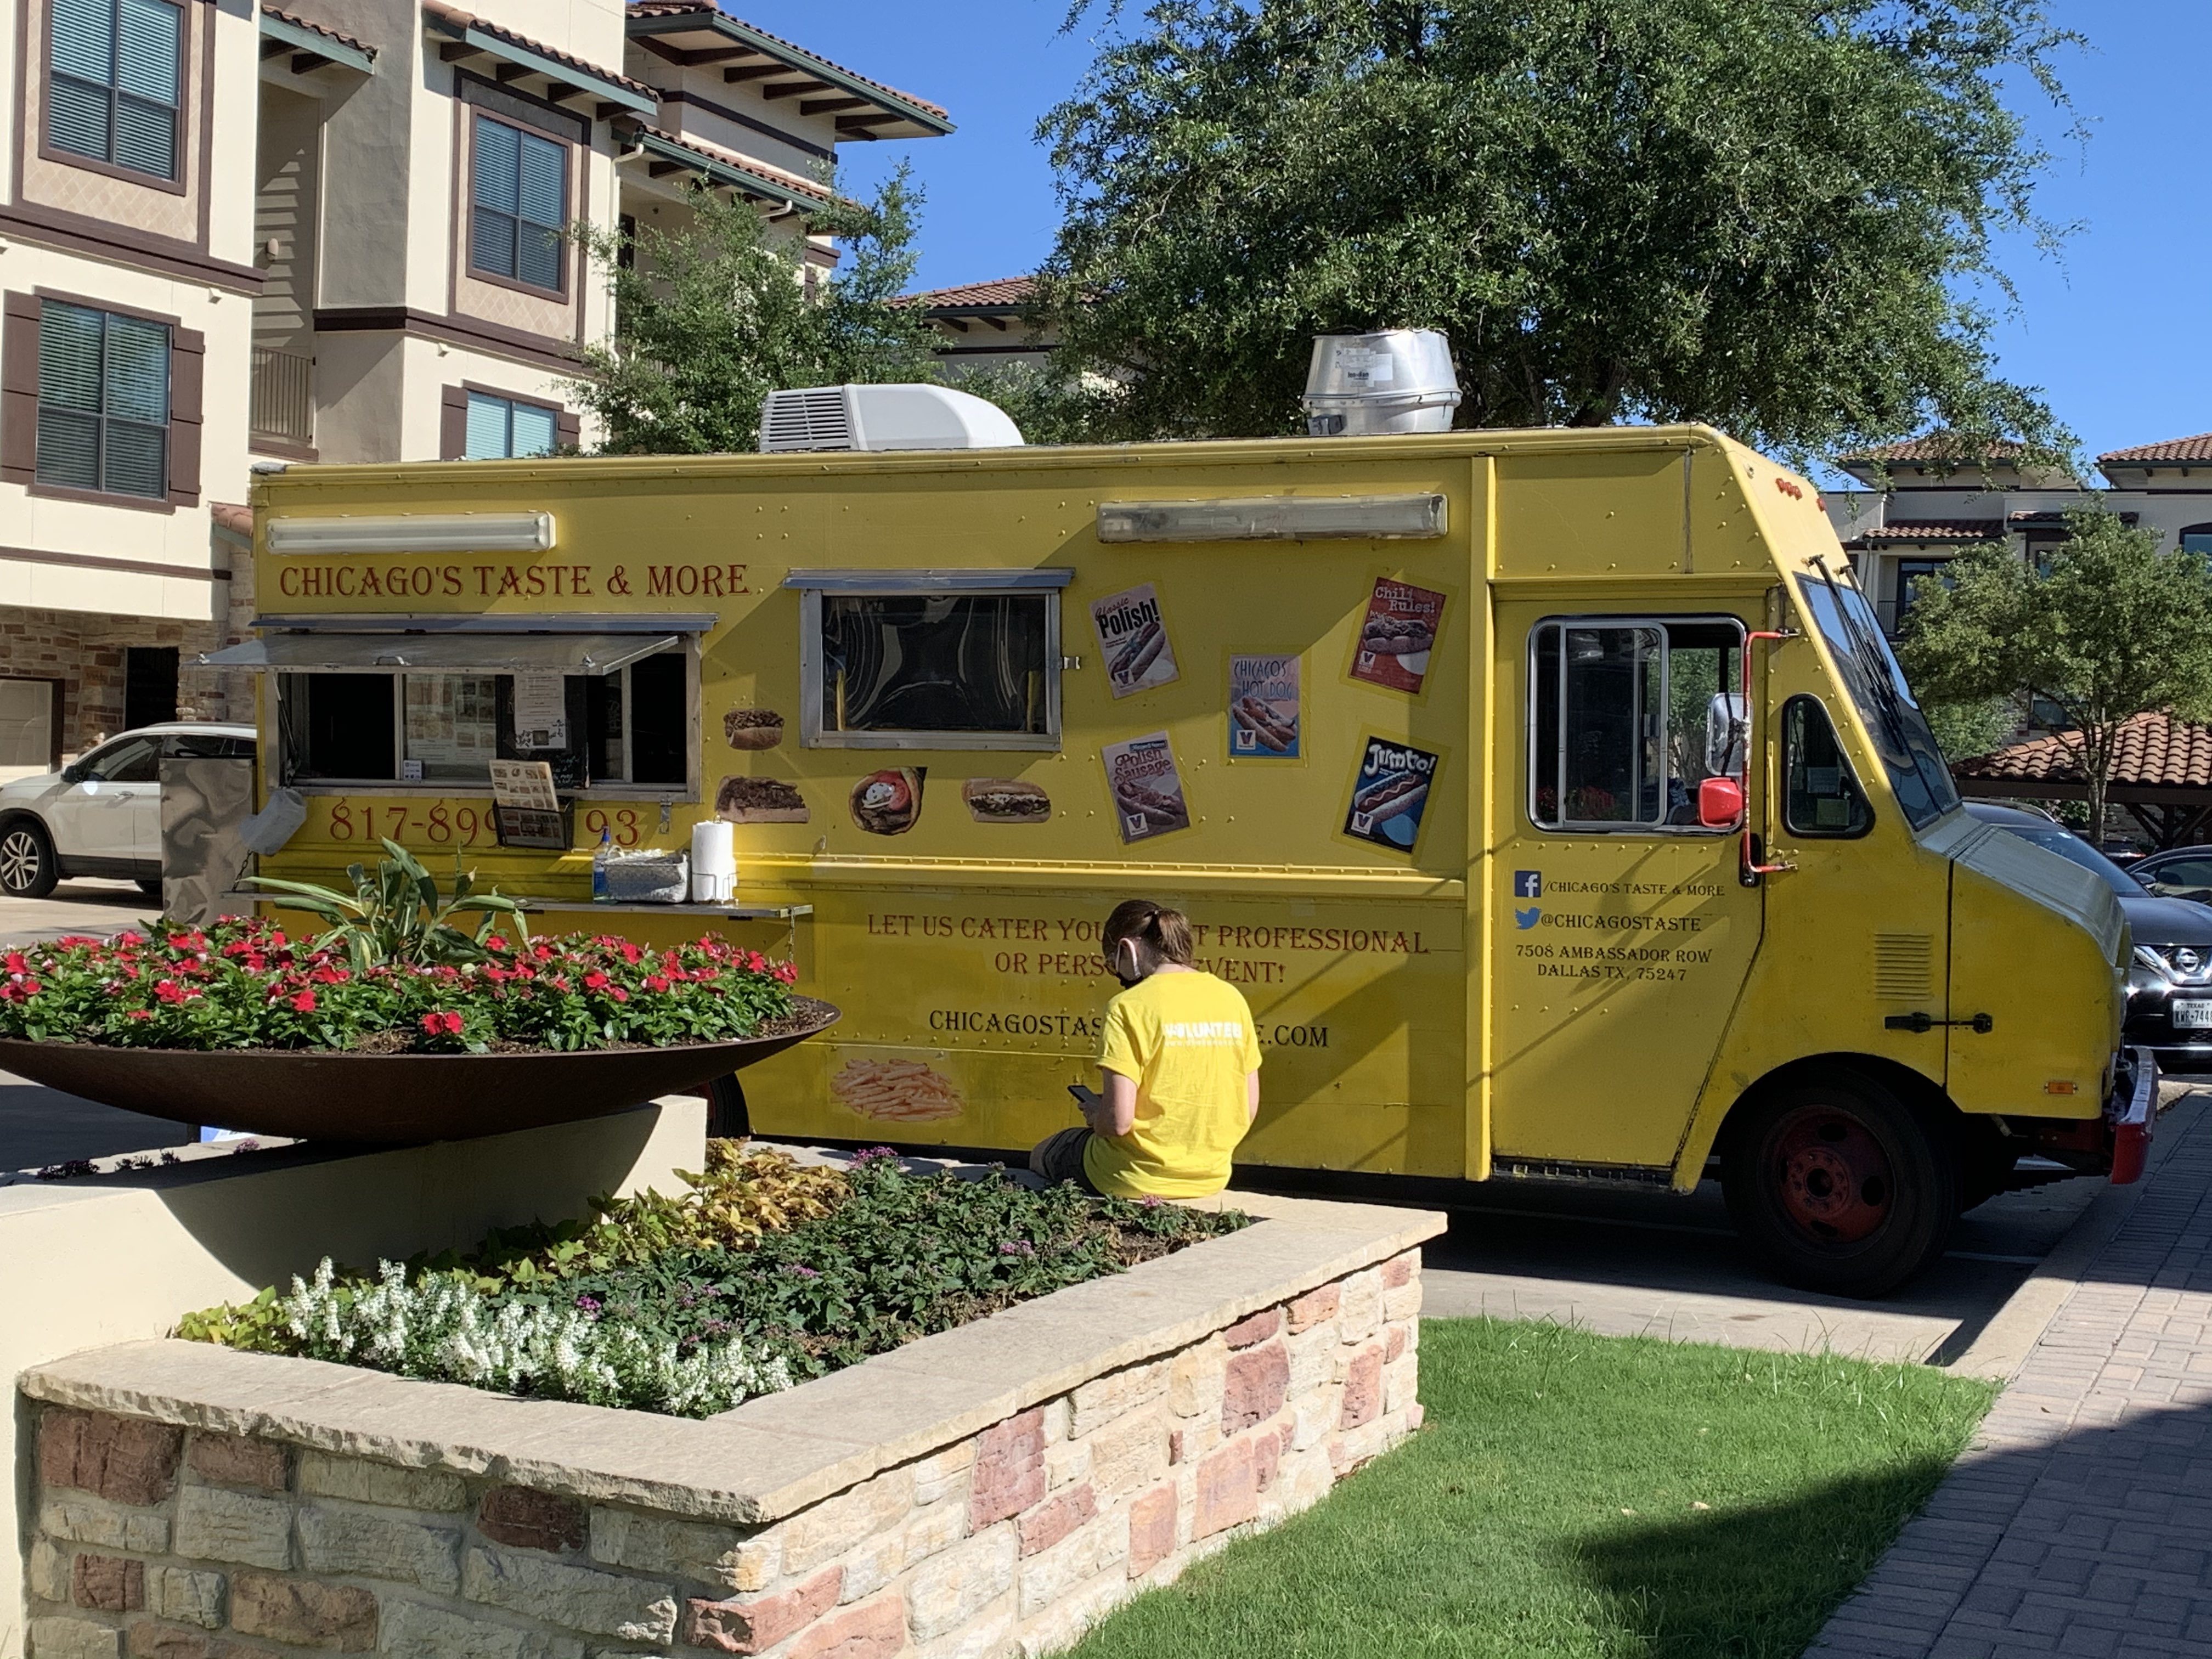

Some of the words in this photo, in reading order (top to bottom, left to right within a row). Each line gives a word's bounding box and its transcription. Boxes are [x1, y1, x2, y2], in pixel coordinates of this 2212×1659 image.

[280, 566, 464, 597] CHICAGO'S
[473, 565, 595, 597] TASTE
[607, 565, 633, 597] &
[646, 564, 752, 598] MORE
[1375, 586, 1414, 601] Chili
[1389, 600, 1435, 614] Rules!
[1098, 597, 1160, 639] Polish!
[1242, 681, 1265, 697] HOT
[1270, 681, 1293, 701] DOG
[1115, 747, 1164, 766] Polish
[1364, 744, 1436, 777] Jumbo!
[1114, 759, 1172, 785] Sausage
[1543, 881, 1620, 894] /CHICAGO'S
[1626, 883, 1668, 895] TASTE
[1673, 885, 1682, 895] &
[1687, 885, 1725, 896] MORE
[1541, 914, 1701, 932] @CHICAGOSTASTE
[868, 914, 914, 936] LET
[923, 916, 954, 938] US
[961, 917, 1048, 942] CATER
[1057, 918, 1105, 943] YOU
[1218, 925, 1430, 954] PROFESSIONAL
[1516, 943, 1554, 957] 7508
[1559, 946, 1670, 962] AMBASSADOR
[1675, 947, 1712, 963] ROW
[995, 952, 1029, 975] OR
[1537, 964, 1601, 978] DALLAS
[1637, 968, 1686, 981] 75247
